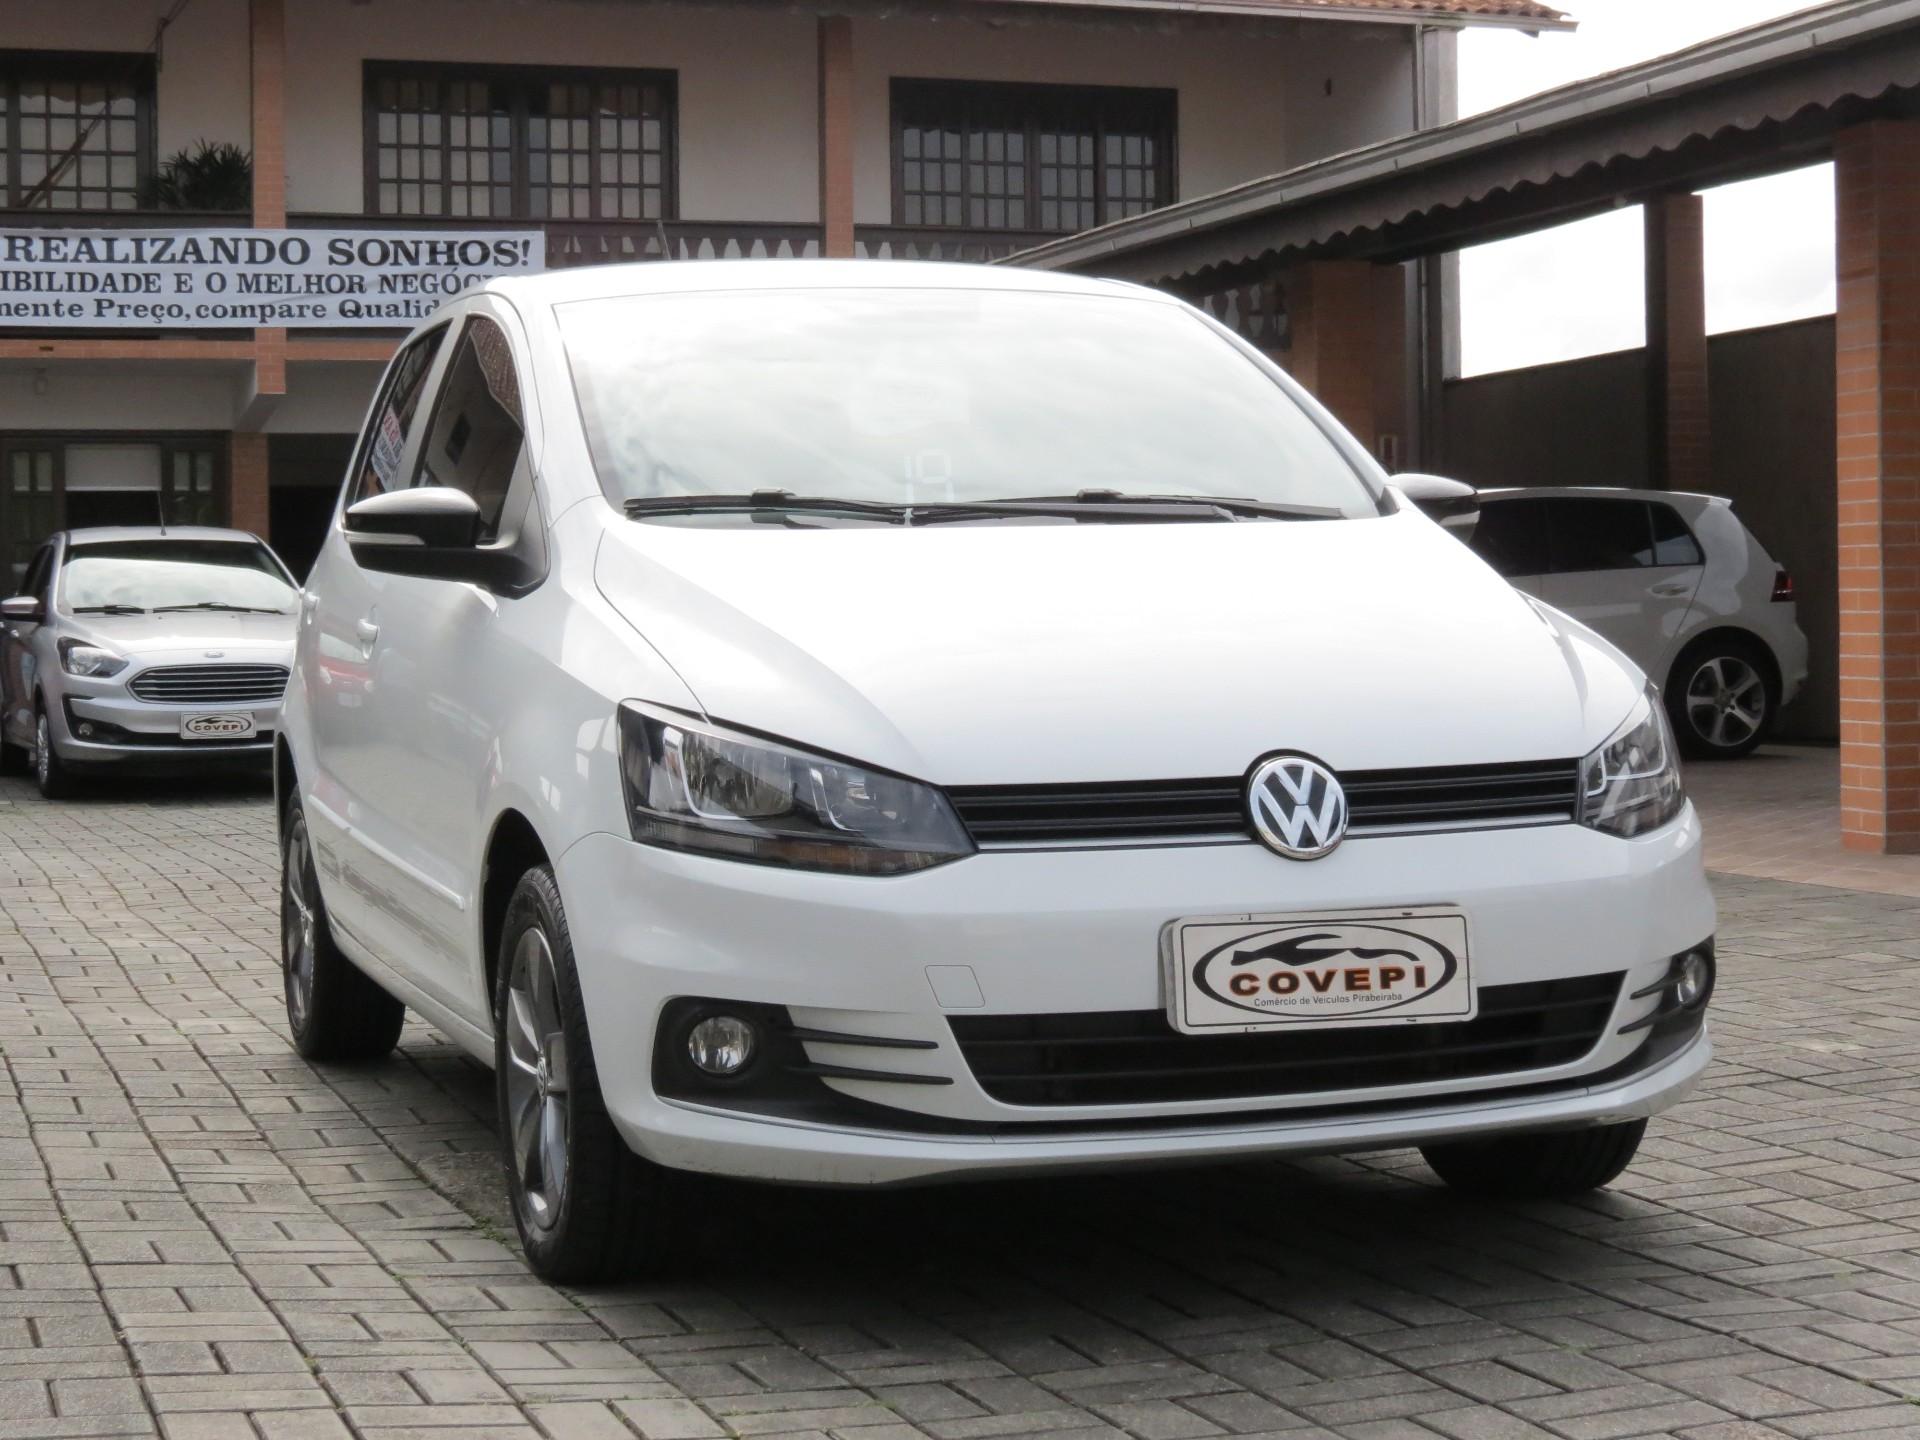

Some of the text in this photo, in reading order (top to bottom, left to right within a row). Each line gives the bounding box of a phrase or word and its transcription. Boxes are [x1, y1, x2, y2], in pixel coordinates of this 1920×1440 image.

[3, 235, 531, 266] REALIZANDO SONHOS!
[0, 267, 500, 295] IBILIDADE E O MELHOR NEGÓC
[93, 298, 191, 323] Preço,
[195, 303, 327, 323] compare
[1229, 965, 1427, 997] COVEPI
[1300, 996, 1311, 1005] de
